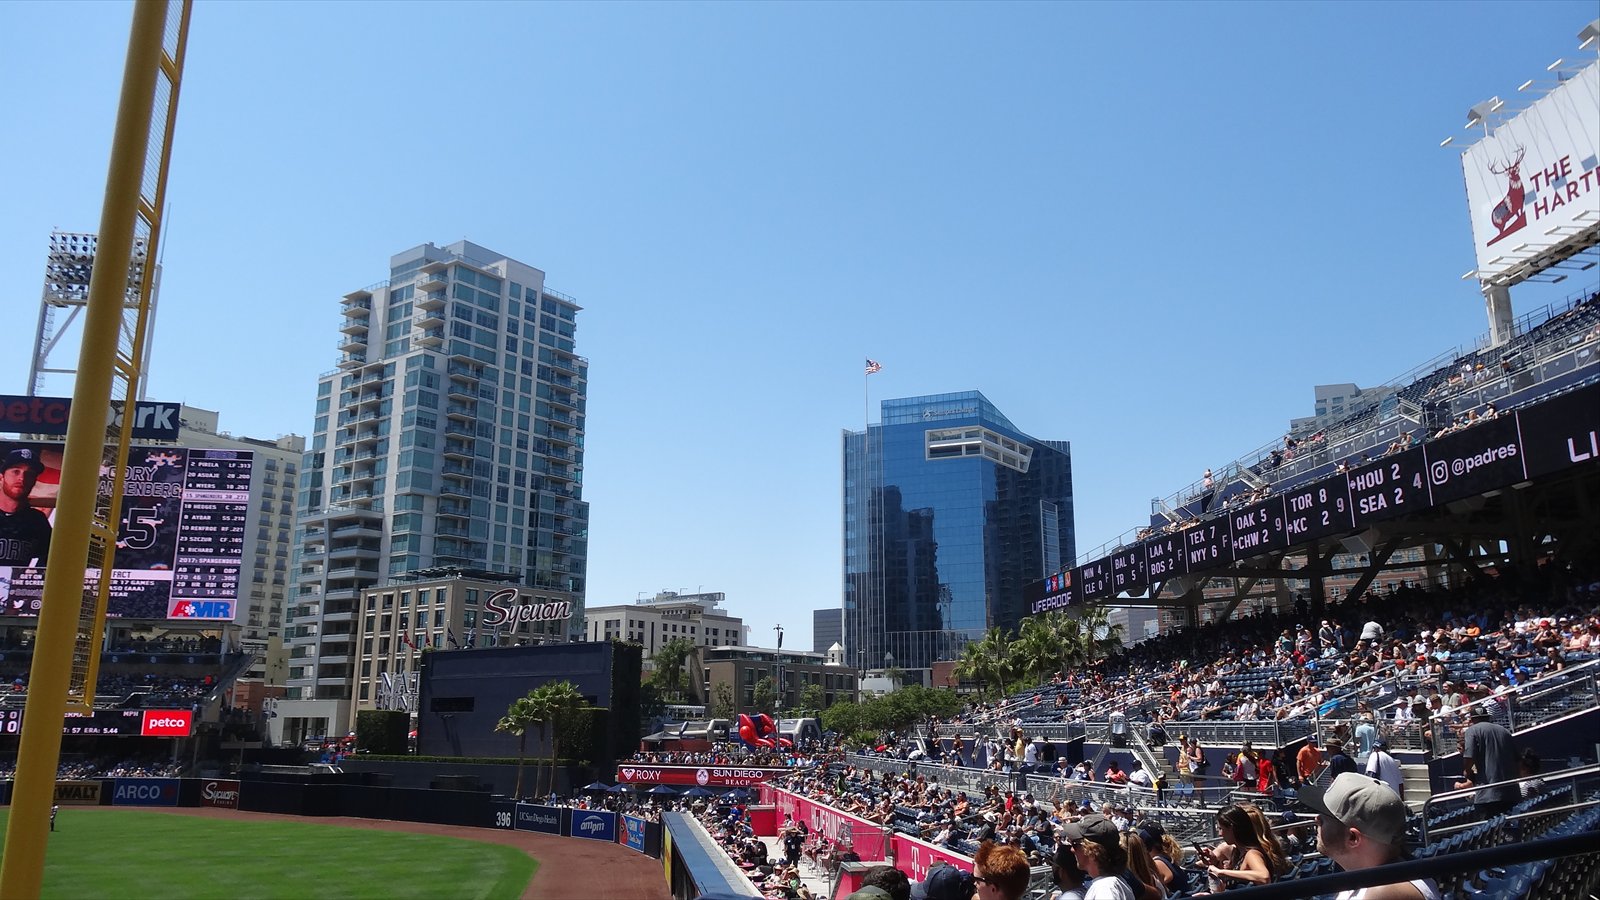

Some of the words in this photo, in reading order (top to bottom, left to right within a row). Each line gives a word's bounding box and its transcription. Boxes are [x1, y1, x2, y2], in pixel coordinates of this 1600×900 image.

[1529, 154, 1573, 193] THE
[0, 400, 68, 424] etc
[1451, 442, 1517, 476] @padres
[1356, 468, 1384, 492] HOU
[1391, 463, 1401, 481] 2
[1412, 472, 1422, 490] 4
[1290, 493, 1313, 512] TOR
[1319, 488, 1327, 504] 8
[1336, 498, 1344, 512] 9
[1359, 491, 1388, 515] SEA
[1394, 487, 1404, 505] 2
[1236, 512, 1256, 530] OAK
[1260, 508, 1267, 522] 5
[1274, 518, 1281, 532] 9
[1292, 516, 1308, 534] KC
[1322, 510, 1330, 526] 2
[1189, 530, 1206, 545] TEX
[1210, 526, 1216, 539] 7
[1222, 534, 1228, 548] F
[1238, 531, 1259, 550] CHW
[1262, 529, 1269, 543] 2
[1150, 544, 1164, 558] LAA
[1167, 540, 1172, 552] 4
[1178, 549, 1182, 561] F
[1191, 548, 1206, 564] NYY
[1212, 545, 1218, 558] 6
[1097, 564, 1102, 575] 4
[1114, 556, 1127, 570] BAL
[1130, 554, 1135, 564] 8
[1140, 561, 1144, 573] F
[1150, 560, 1166, 576] BOS
[1168, 558, 1174, 570] 2
[1105, 572, 1109, 583] F
[1116, 573, 1124, 586] TB
[1132, 570, 1136, 580] 5
[1084, 582, 1096, 594] CLE
[171, 600, 230, 618] AMR
[482, 588, 574, 634] Sycuan
[1031, 591, 1072, 614] LIFEPROOF
[149, 718, 185, 729] petco
[636, 770, 662, 780] ROXY
[713, 770, 732, 778] SUN
[733, 770, 763, 778] DIEGO
[55, 785, 98, 800] WALT
[115, 785, 160, 800] ARCO
[496, 812, 511, 827] 396
[580, 820, 605, 834] ampm
